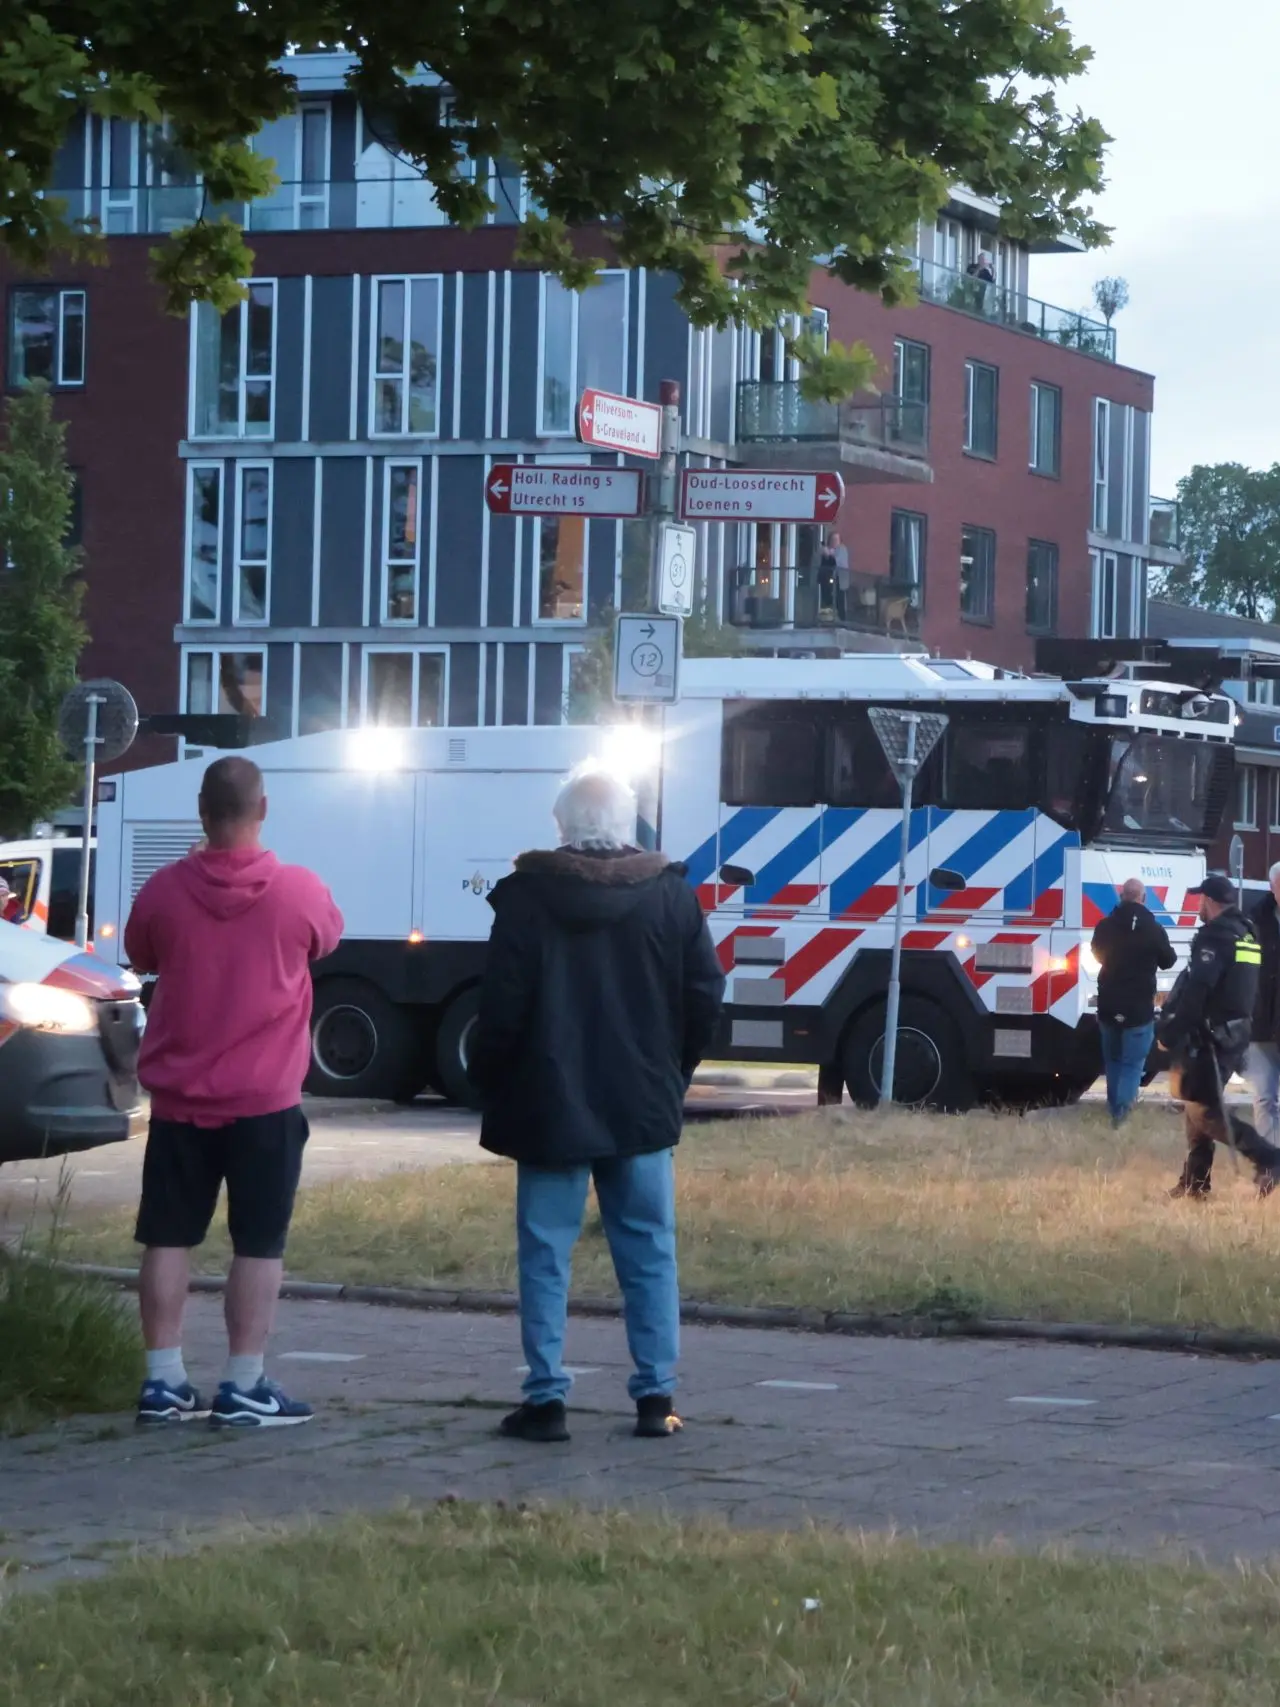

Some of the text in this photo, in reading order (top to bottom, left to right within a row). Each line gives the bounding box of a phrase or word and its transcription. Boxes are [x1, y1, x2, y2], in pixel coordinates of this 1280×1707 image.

[595, 399, 633, 420] Hilversum
[514, 471, 612, 489] Holl. Rading 5
[689, 476, 805, 491] Oud-Loosdrecht
[513, 492, 585, 507] Utrecht 15
[689, 497, 753, 512] Loenen 9
[671, 564, 683, 579] 31
[639, 652, 658, 668] 12
[1140, 865, 1173, 878] POLITIE
